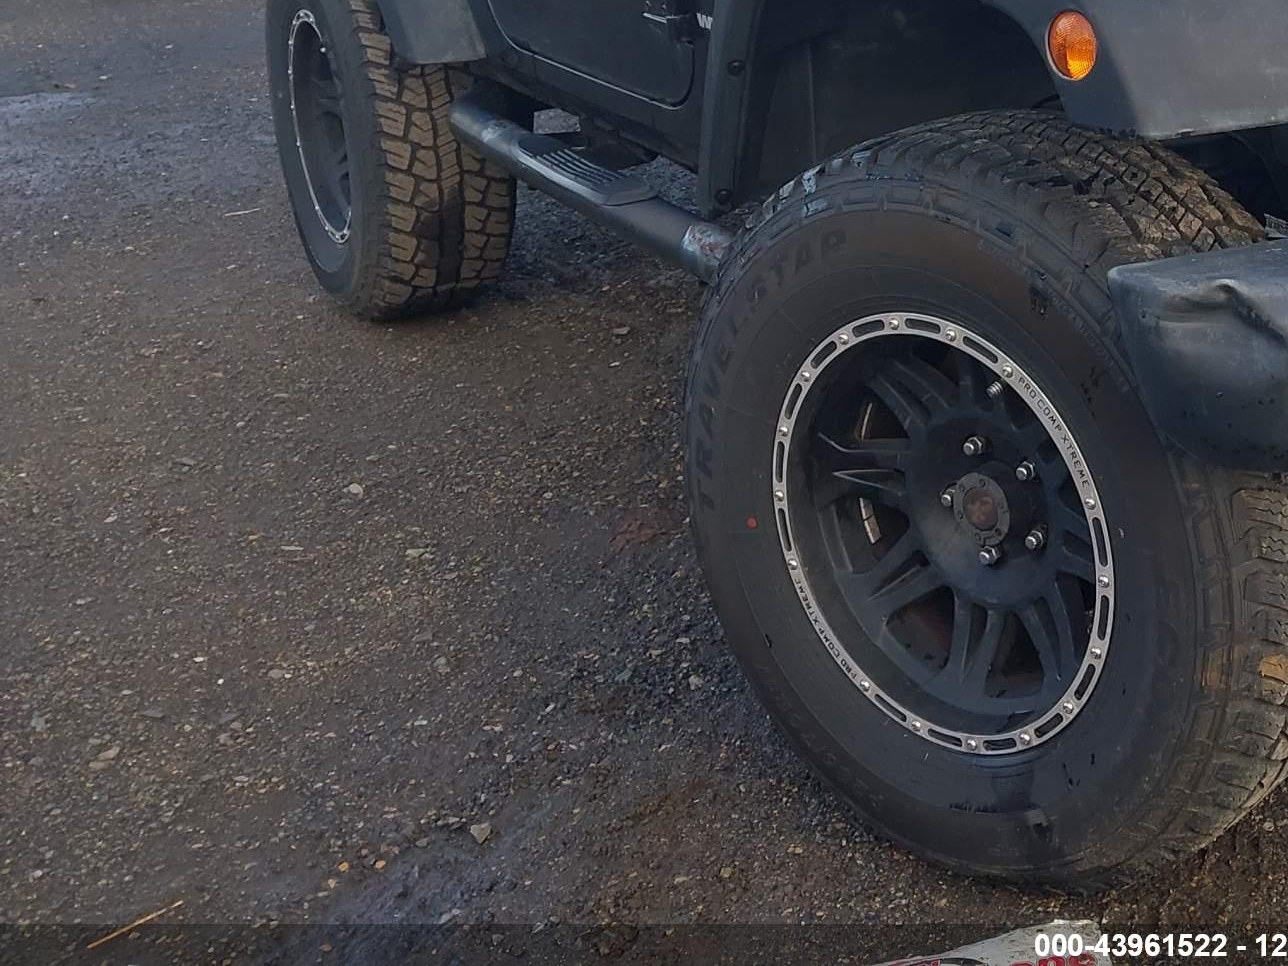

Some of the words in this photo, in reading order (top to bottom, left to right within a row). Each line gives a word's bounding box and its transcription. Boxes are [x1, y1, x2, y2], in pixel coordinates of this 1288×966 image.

[1018, 376, 1037, 400] PRO
[1036, 398, 1062, 432] COMP
[1060, 434, 1090, 488] XTREME
[818, 627, 841, 659] COMP
